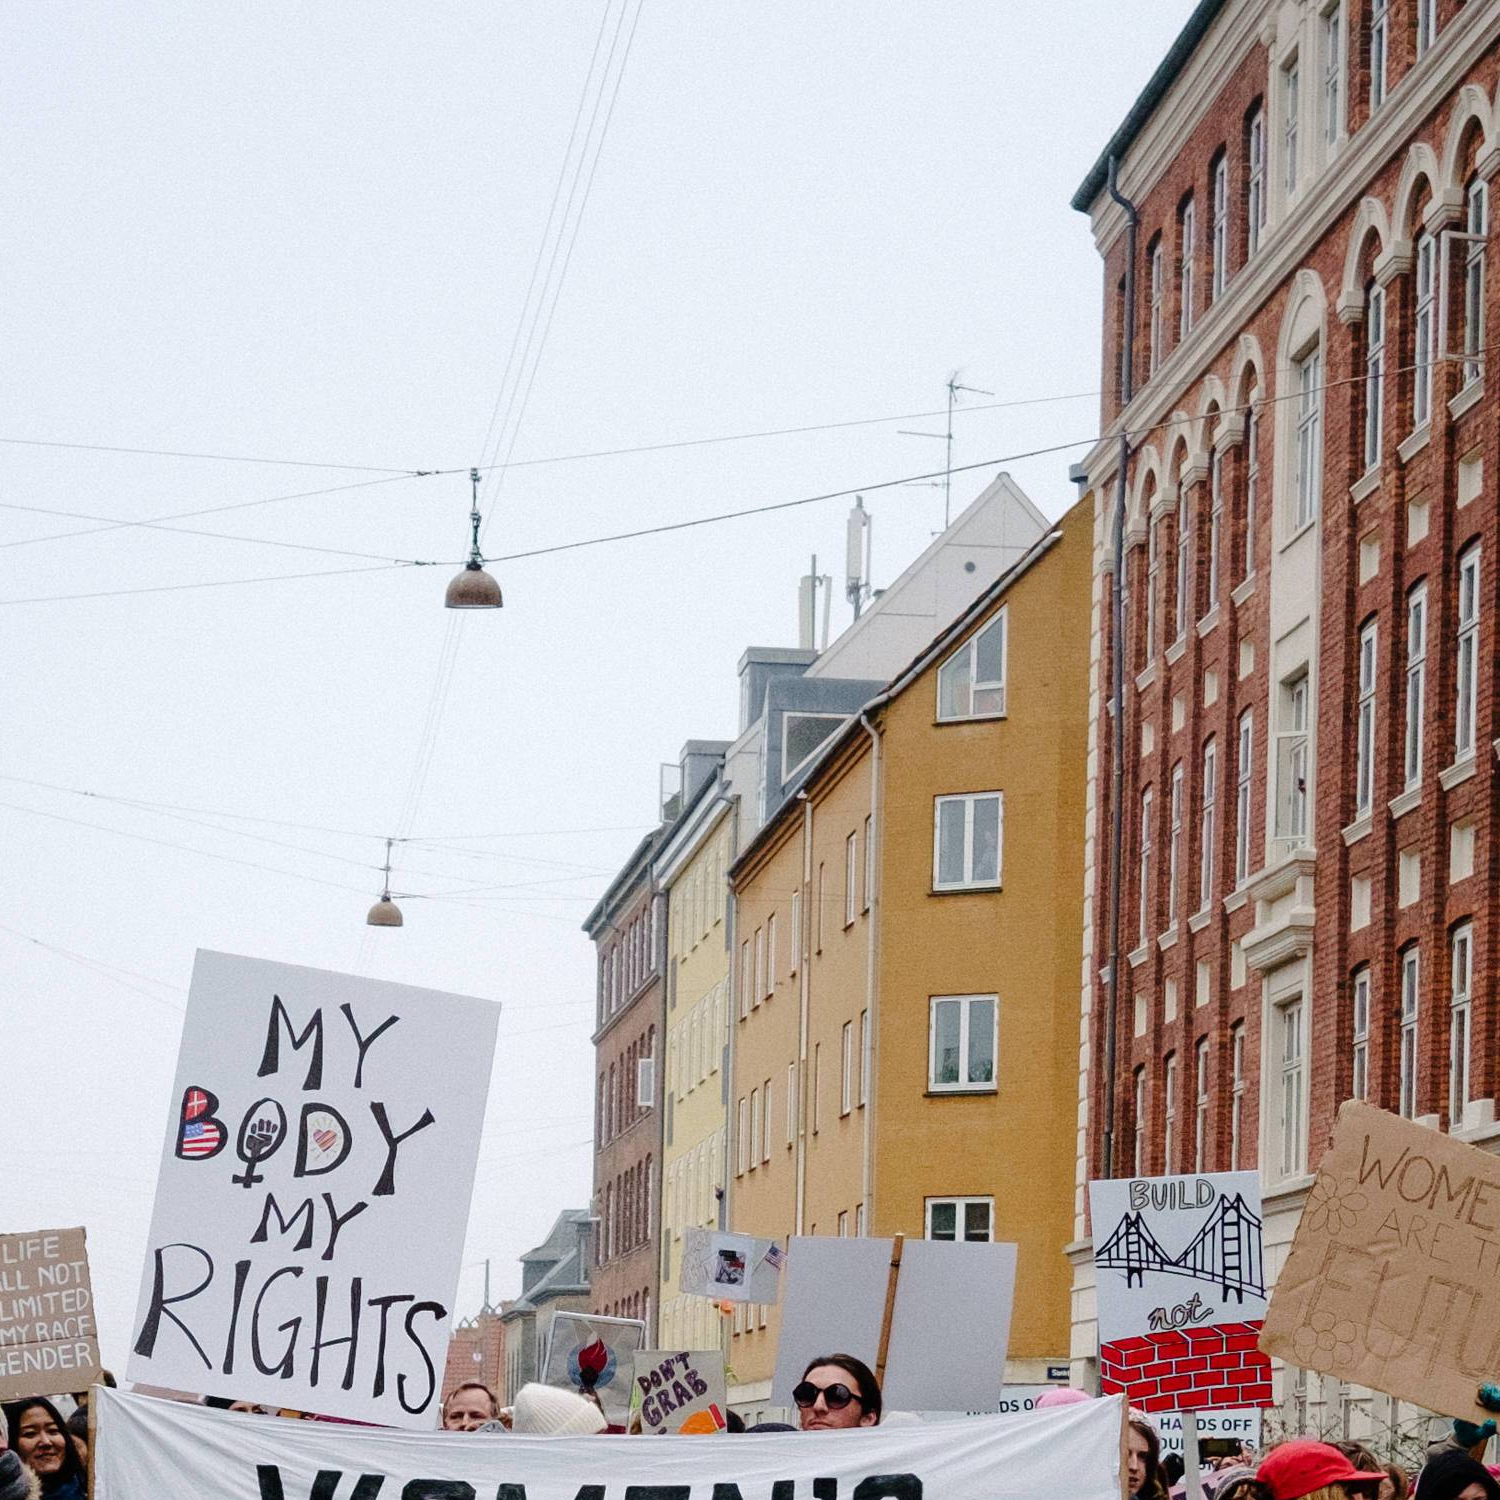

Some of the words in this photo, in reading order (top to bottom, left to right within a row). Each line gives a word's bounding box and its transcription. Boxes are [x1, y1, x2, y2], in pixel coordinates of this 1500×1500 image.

[257, 995, 399, 1090] MY
[175, 1086, 436, 1196] BODY
[1129, 1179, 1215, 1211] BUILD
[2, 1236, 60, 1264] LIFE
[251, 1193, 368, 1261] MY
[1374, 1208, 1454, 1263] ARE
[37, 1261, 84, 1287] NOT
[134, 1243, 447, 1415] RIGHTS
[1147, 1292, 1214, 1330] not
[0, 1324, 29, 1349] MY
[642, 1369, 707, 1426] GRAB
[1160, 1417, 1217, 1431] HADS
[1222, 1418, 1253, 1431] OFF
